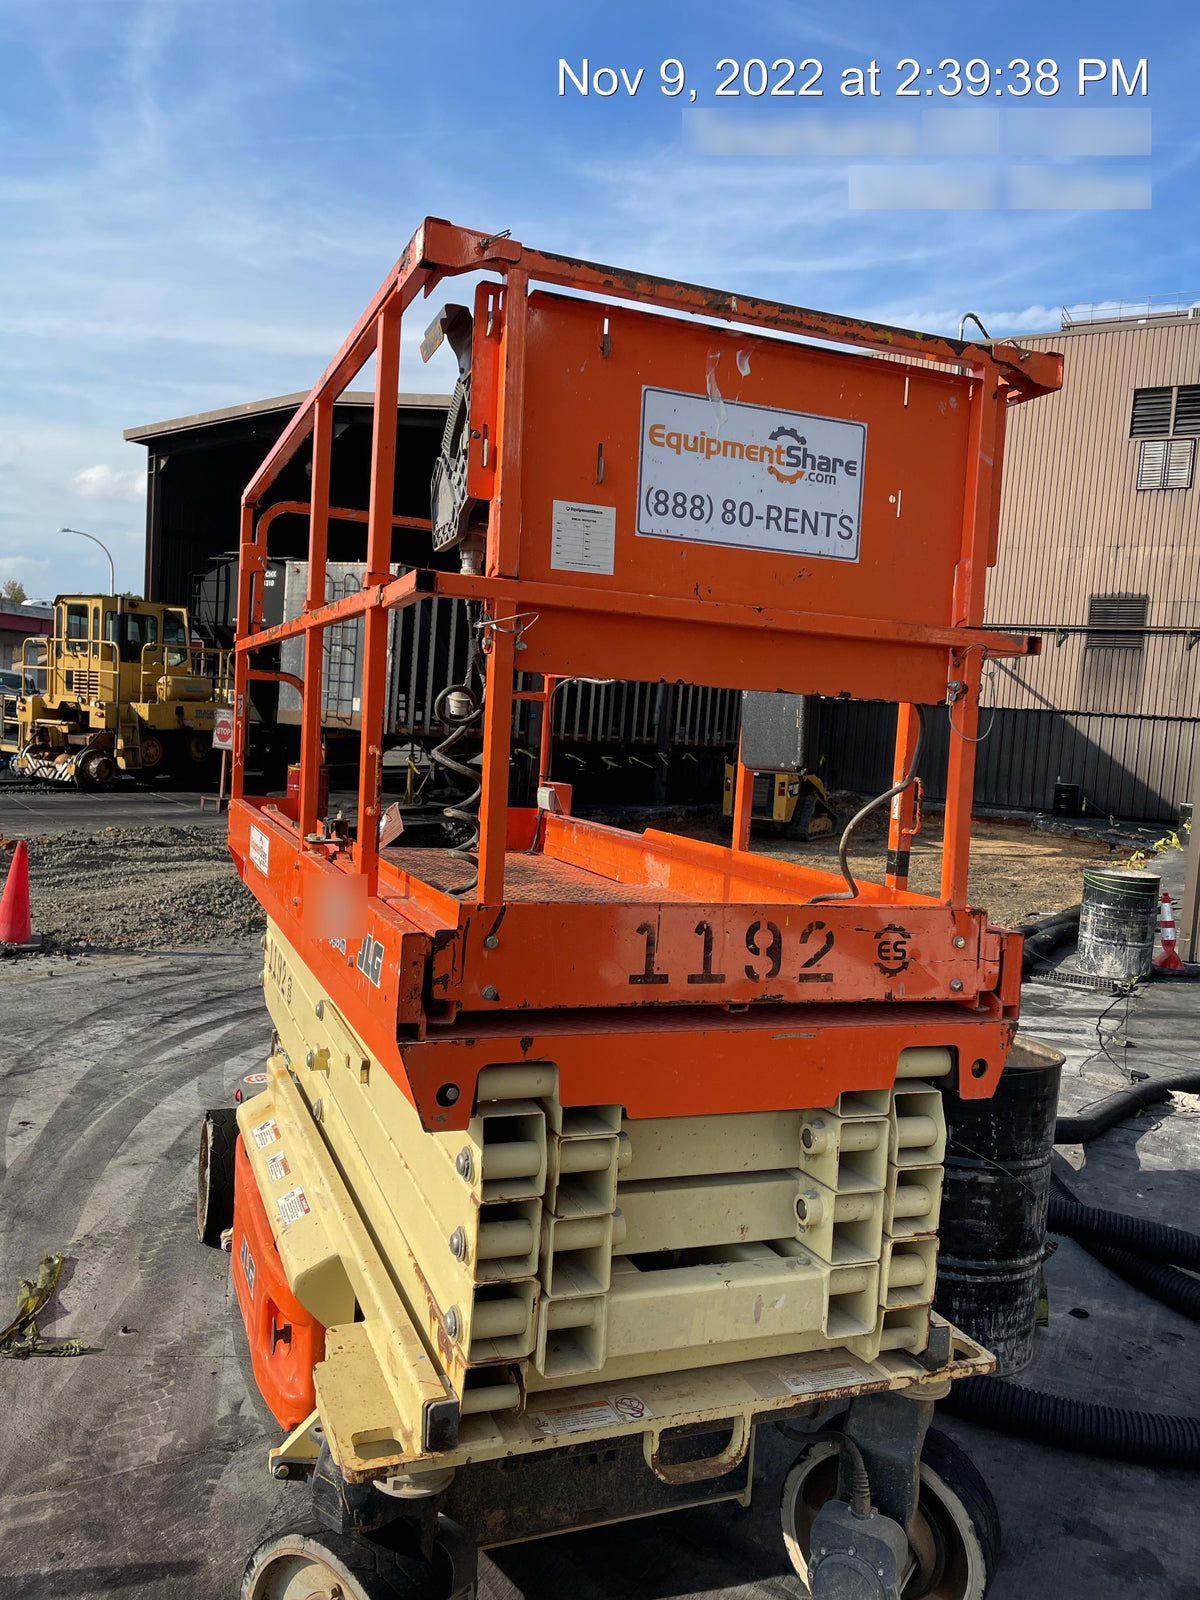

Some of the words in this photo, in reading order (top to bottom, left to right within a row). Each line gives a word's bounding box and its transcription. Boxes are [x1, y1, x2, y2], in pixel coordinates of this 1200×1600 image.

[648, 423, 858, 477] EquipmentShare
[804, 471, 837, 486] .com
[645, 486, 714, 524] (888)
[720, 498, 855, 541] 80-RENTS
[216, 727, 231, 736] STOP
[356, 932, 385, 989] JLG
[628, 920, 835, 985] 1192
[877, 940, 907, 961] ES
